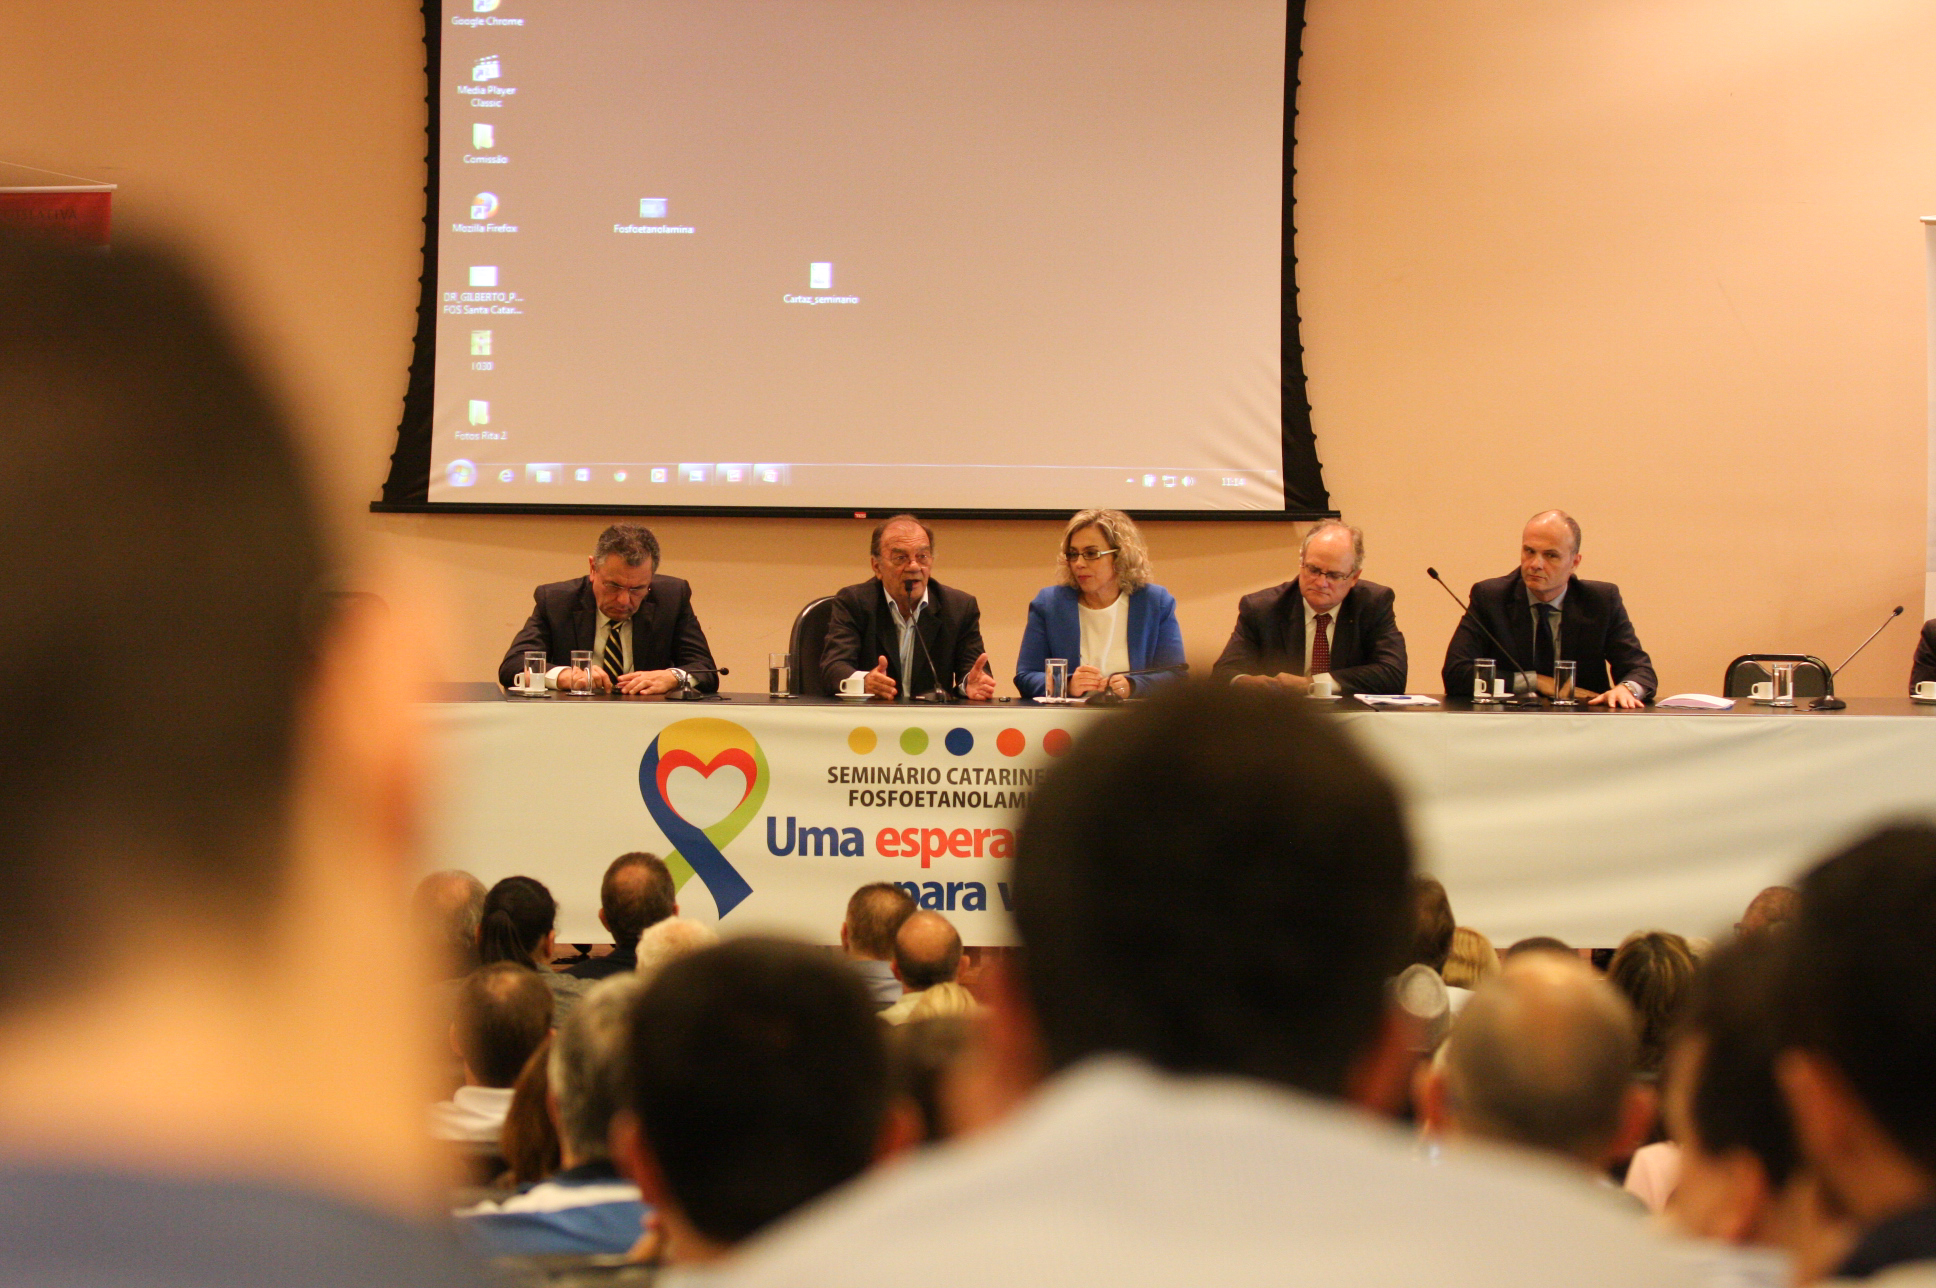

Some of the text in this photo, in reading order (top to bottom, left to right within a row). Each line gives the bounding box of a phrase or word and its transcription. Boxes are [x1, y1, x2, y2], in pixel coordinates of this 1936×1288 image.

[451, 16, 524, 28] Google Chrome
[457, 85, 517, 97] Media Player
[470, 98, 503, 108] Classic
[463, 154, 509, 164] Comissão
[452, 223, 518, 233] Mozilla Firefox
[613, 223, 695, 234] Fosfoetanolamina
[443, 305, 462, 315] FOS
[463, 305, 490, 315] Santa
[454, 430, 508, 441] Fotos Rita 2
[827, 763, 1046, 787] SEMINÁRIO CATARINE
[766, 816, 1015, 868] Uma espera
